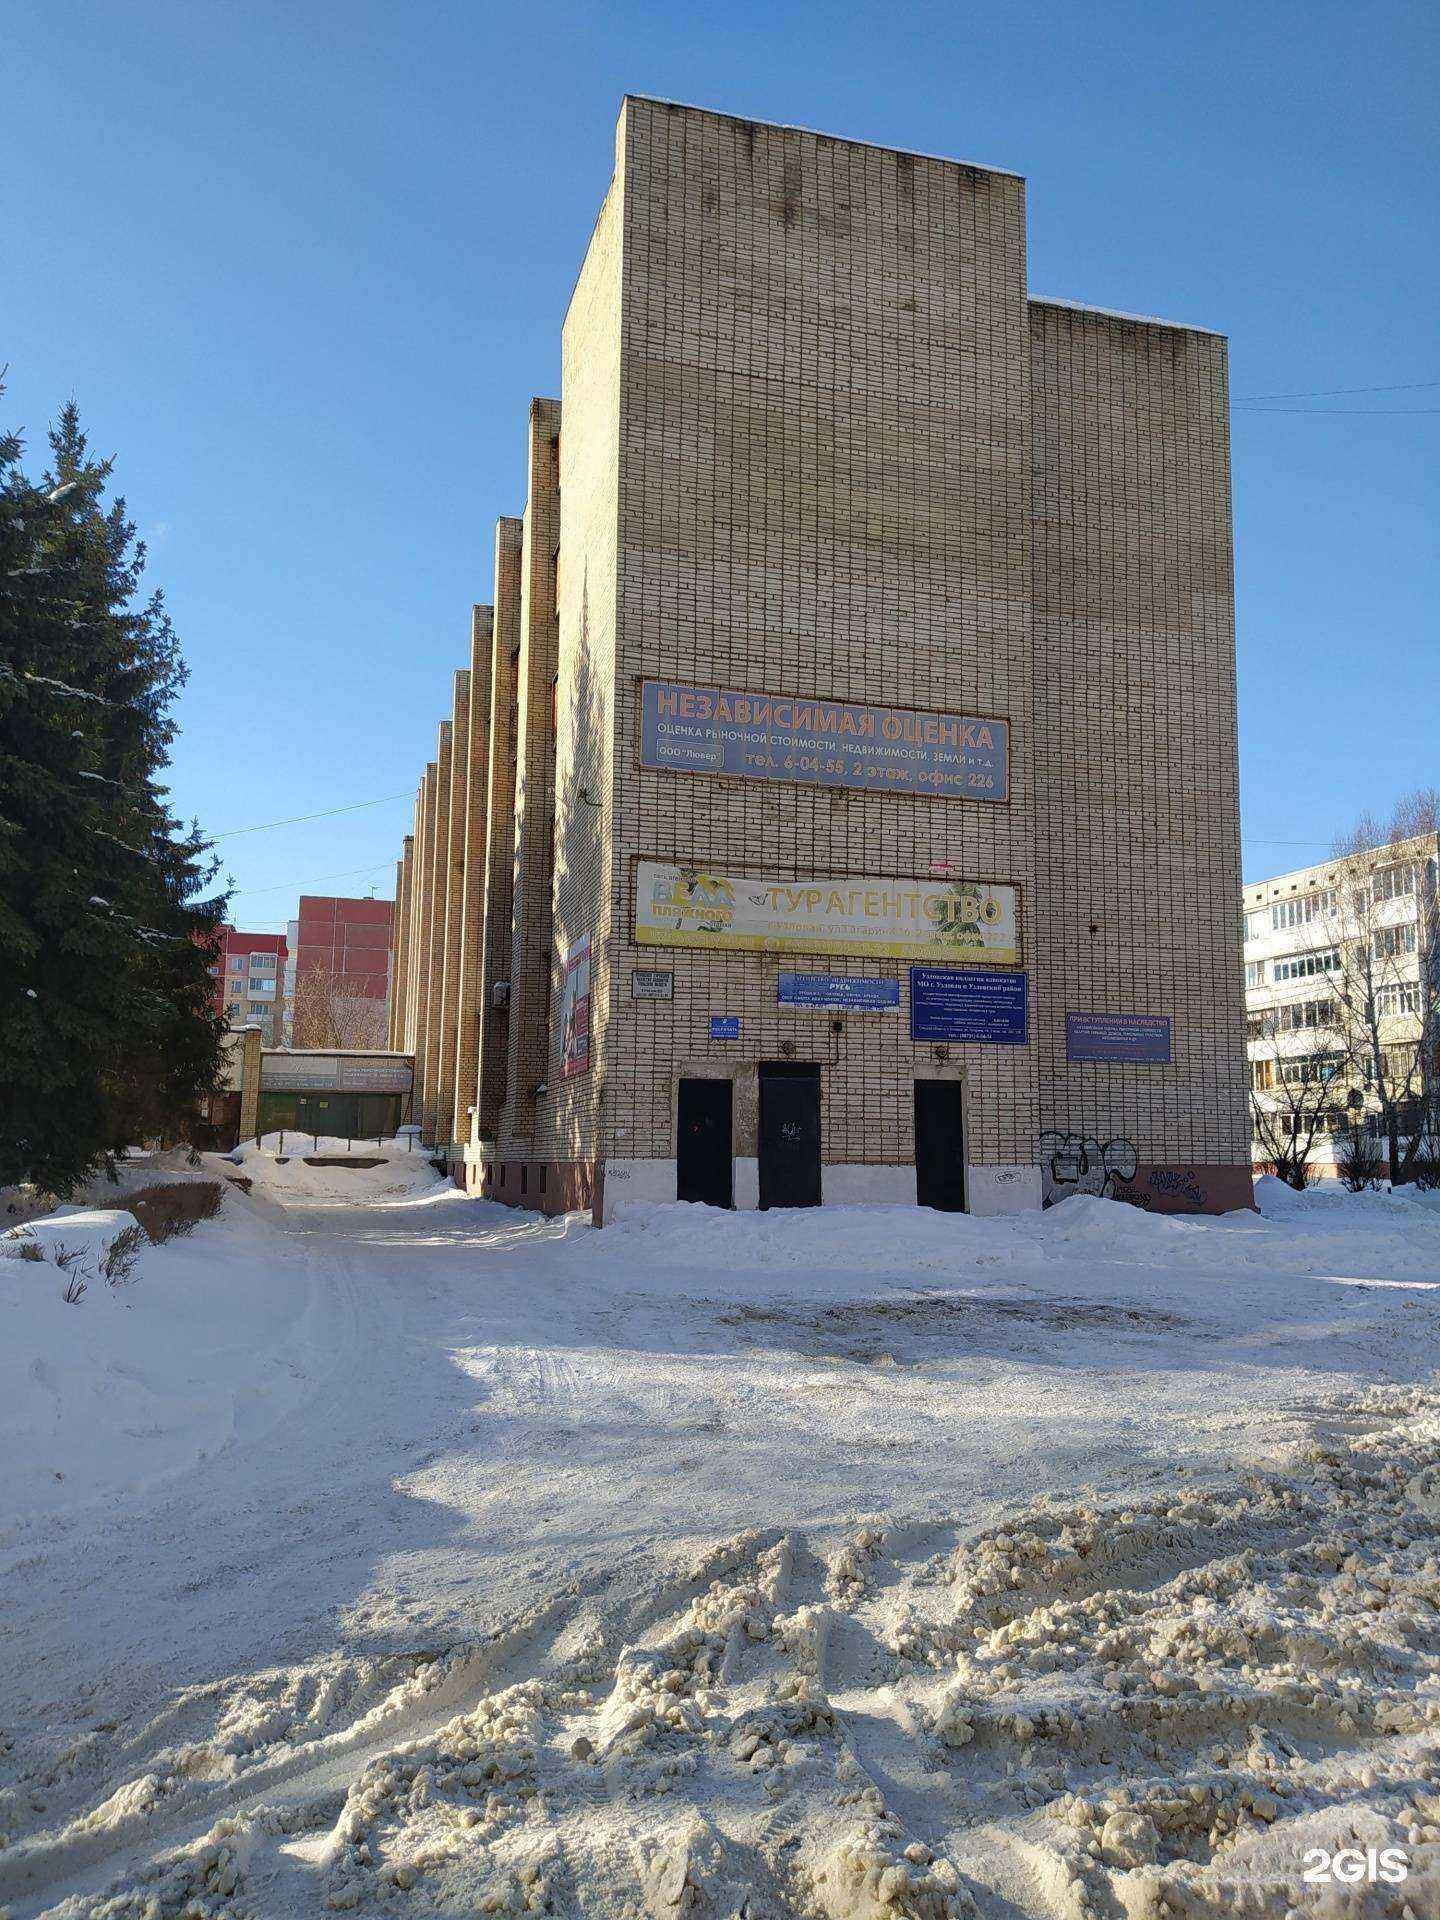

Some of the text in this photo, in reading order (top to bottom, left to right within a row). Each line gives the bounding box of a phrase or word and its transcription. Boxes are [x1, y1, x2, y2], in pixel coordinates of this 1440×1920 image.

[657, 690, 995, 750] НЕЗАВИСИМАЯ ОЦЕНКА
[657, 722, 702, 738] ОЦЕНКА
[705, 728, 767, 744] РЫНОЧНОЙ
[933, 751, 966, 765] ЗЕМЛИ
[745, 753, 778, 768] тел.
[852, 762, 863, 776] 2
[918, 769, 963, 787] офис
[767, 887, 1005, 926] ТУРАГЕНТСТВО
